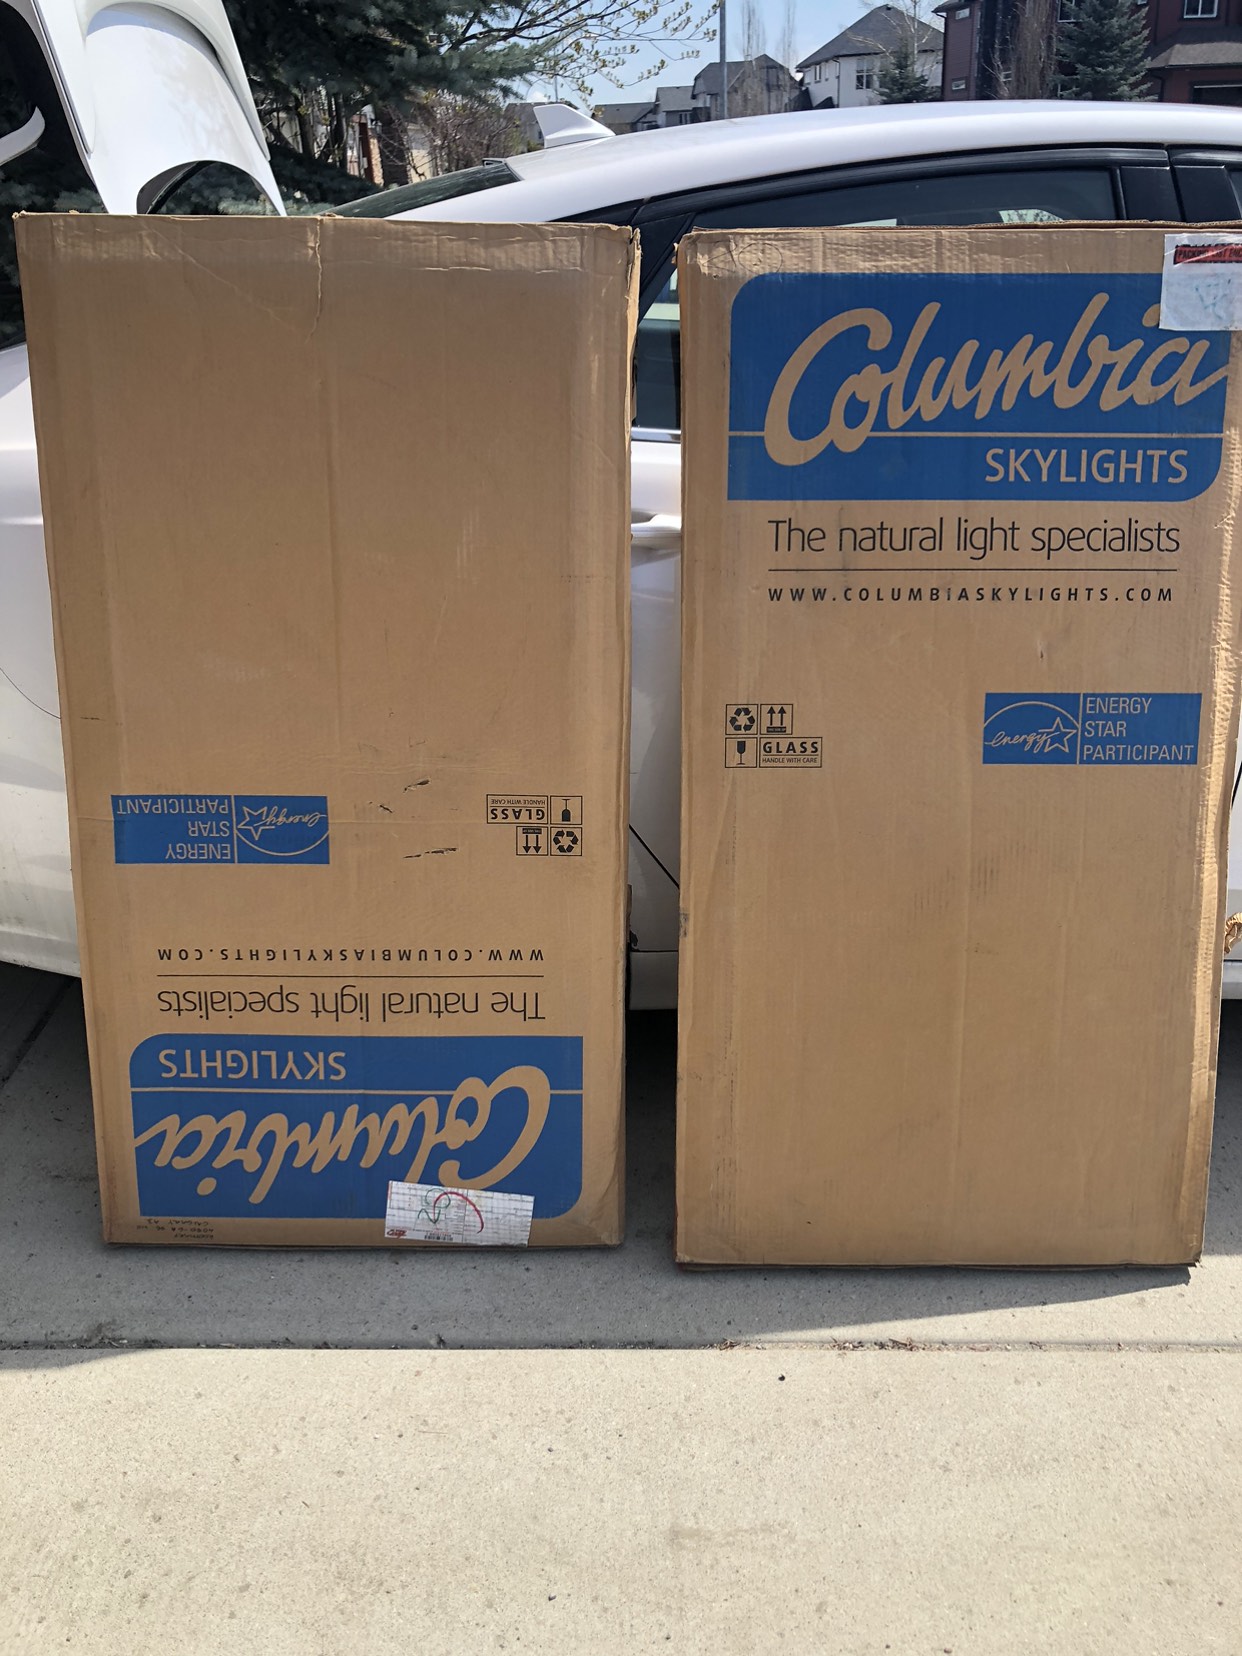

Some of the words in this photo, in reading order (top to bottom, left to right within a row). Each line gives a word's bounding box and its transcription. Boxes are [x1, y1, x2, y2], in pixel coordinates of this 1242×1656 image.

[764, 292, 1230, 466] Columbia
[985, 448, 1189, 484] SKYLIGHTS
[767, 517, 827, 552] The
[839, 516, 944, 552] natural
[956, 516, 1021, 561] light
[1030, 517, 1181, 561] specialists
[1085, 697, 1152, 715] ENERGY
[1084, 720, 1127, 738] STAR
[762, 741, 819, 754] GLASS
[985, 730, 1048, 754] energy
[1082, 744, 1195, 761] PARTICIPANT
[116, 798, 229, 815] PARTICIPANT
[490, 808, 546, 821] GLASS
[187, 820, 231, 838] STAR
[164, 842, 232, 860] ENERGY
[157, 948, 545, 962] WWW.COLUMBIASKYLIGHTS.COM
[157, 984, 301, 1021] specialists
[309, 984, 370, 1023] light
[382, 992, 480, 1023] natural
[490, 991, 546, 1022] The
[158, 1049, 347, 1081] SKYLIGHTS
[134, 1065, 551, 1204] Columbia
